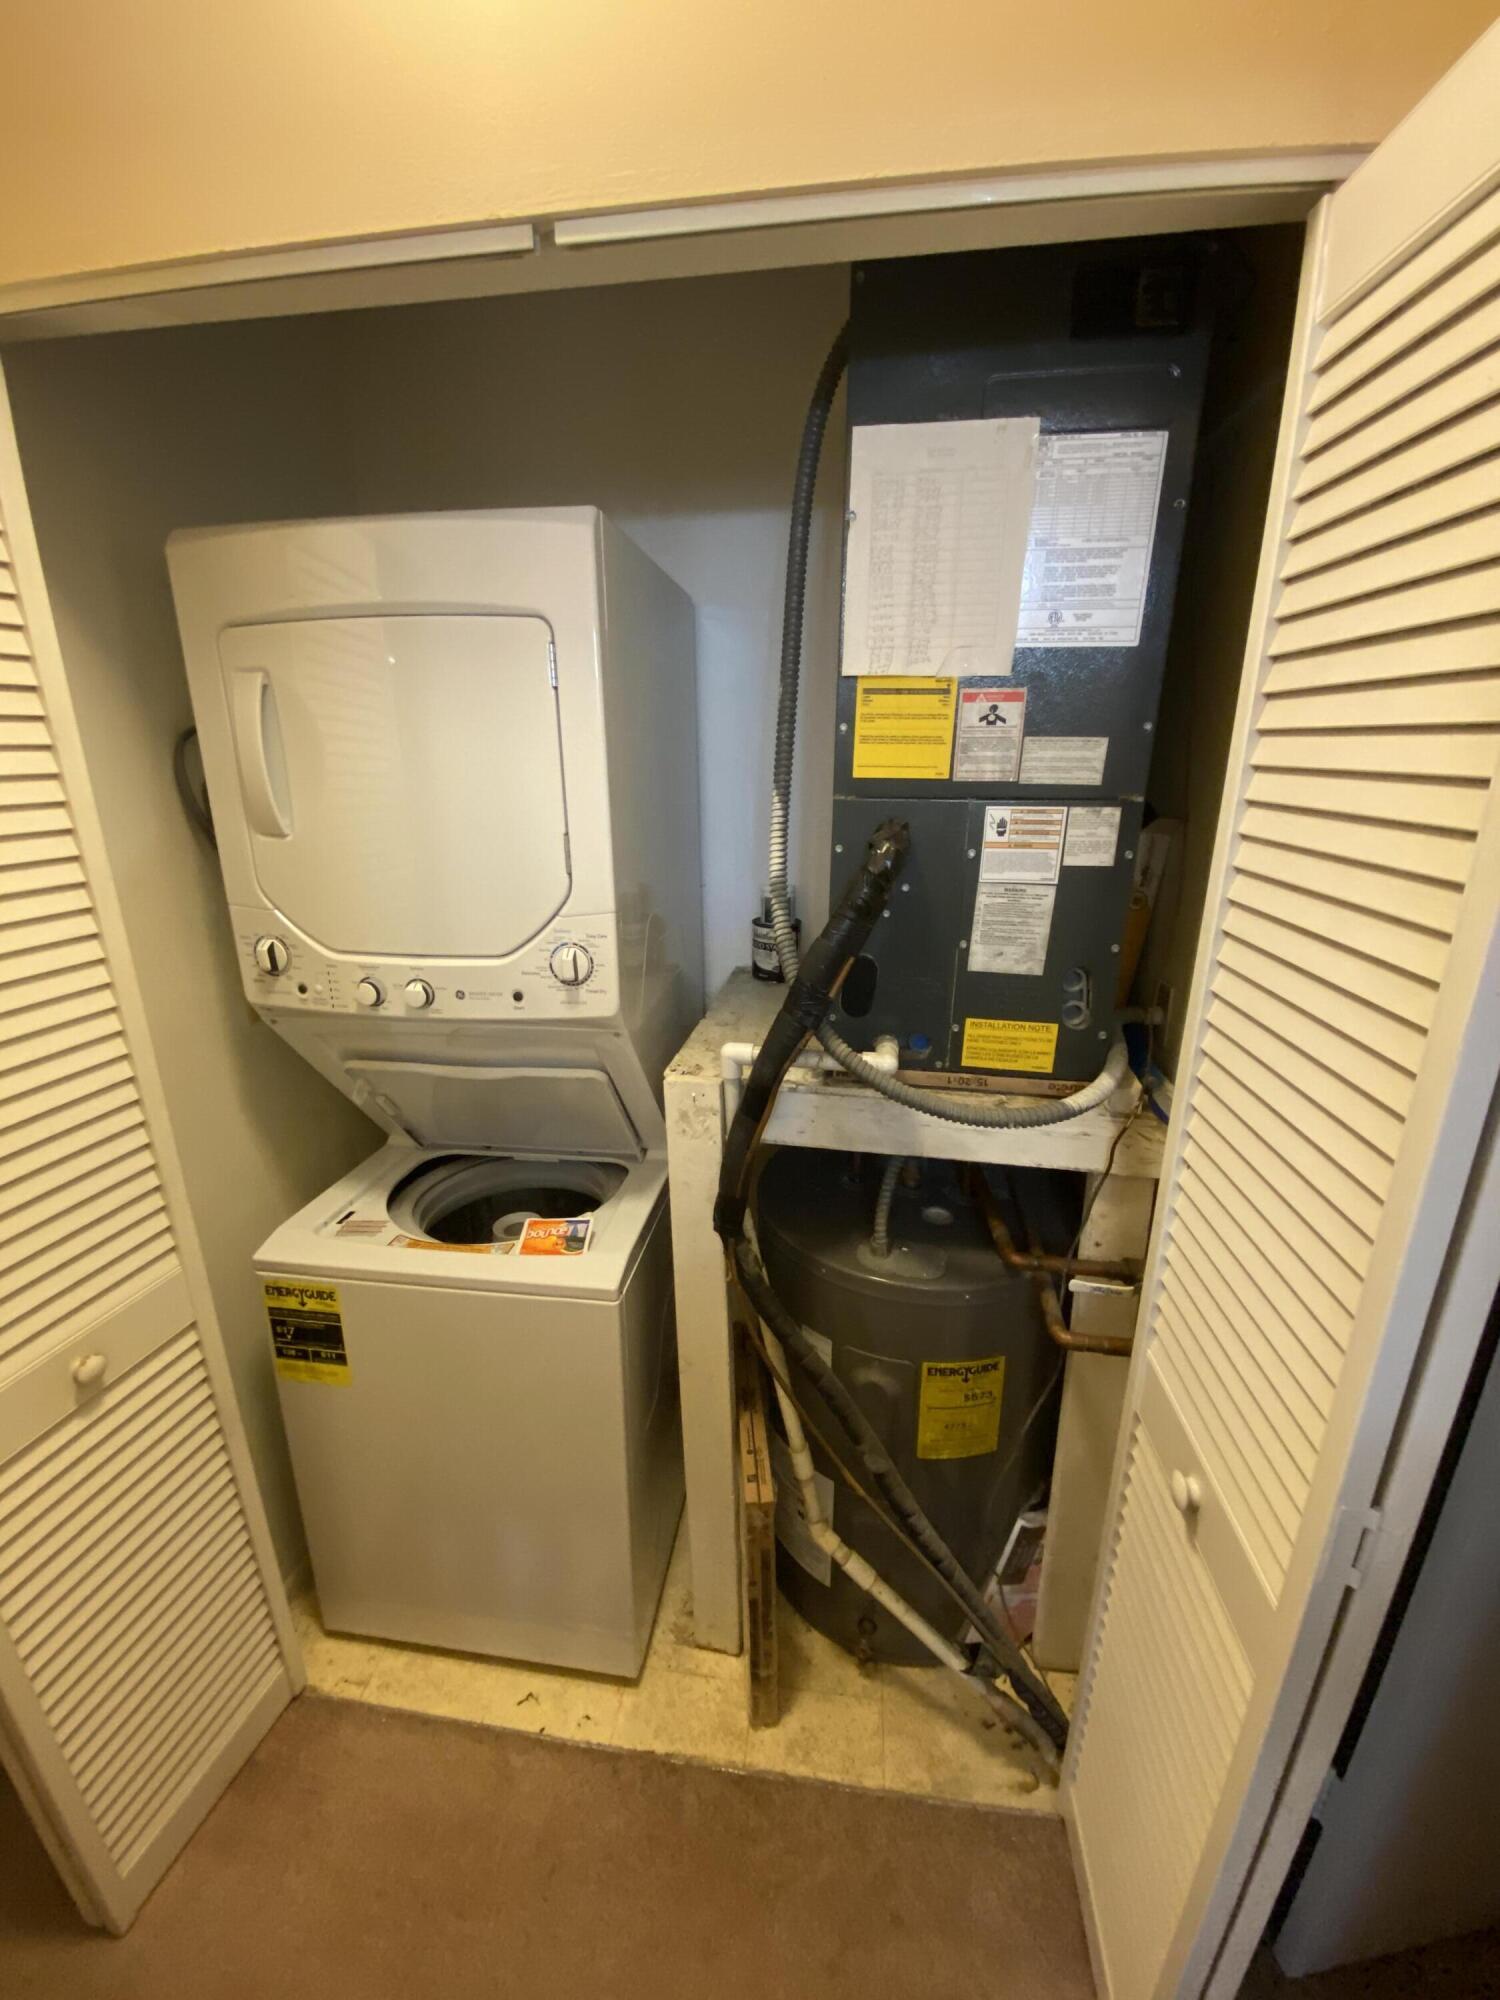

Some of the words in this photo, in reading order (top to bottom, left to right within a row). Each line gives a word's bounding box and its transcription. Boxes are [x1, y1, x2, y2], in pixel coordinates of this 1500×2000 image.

[969, 1021, 1026, 1032] INSTALLATION
[264, 1285, 337, 1303] ENERGYGUIDE
[927, 1362, 1000, 1377] ENERGYGUIDE
